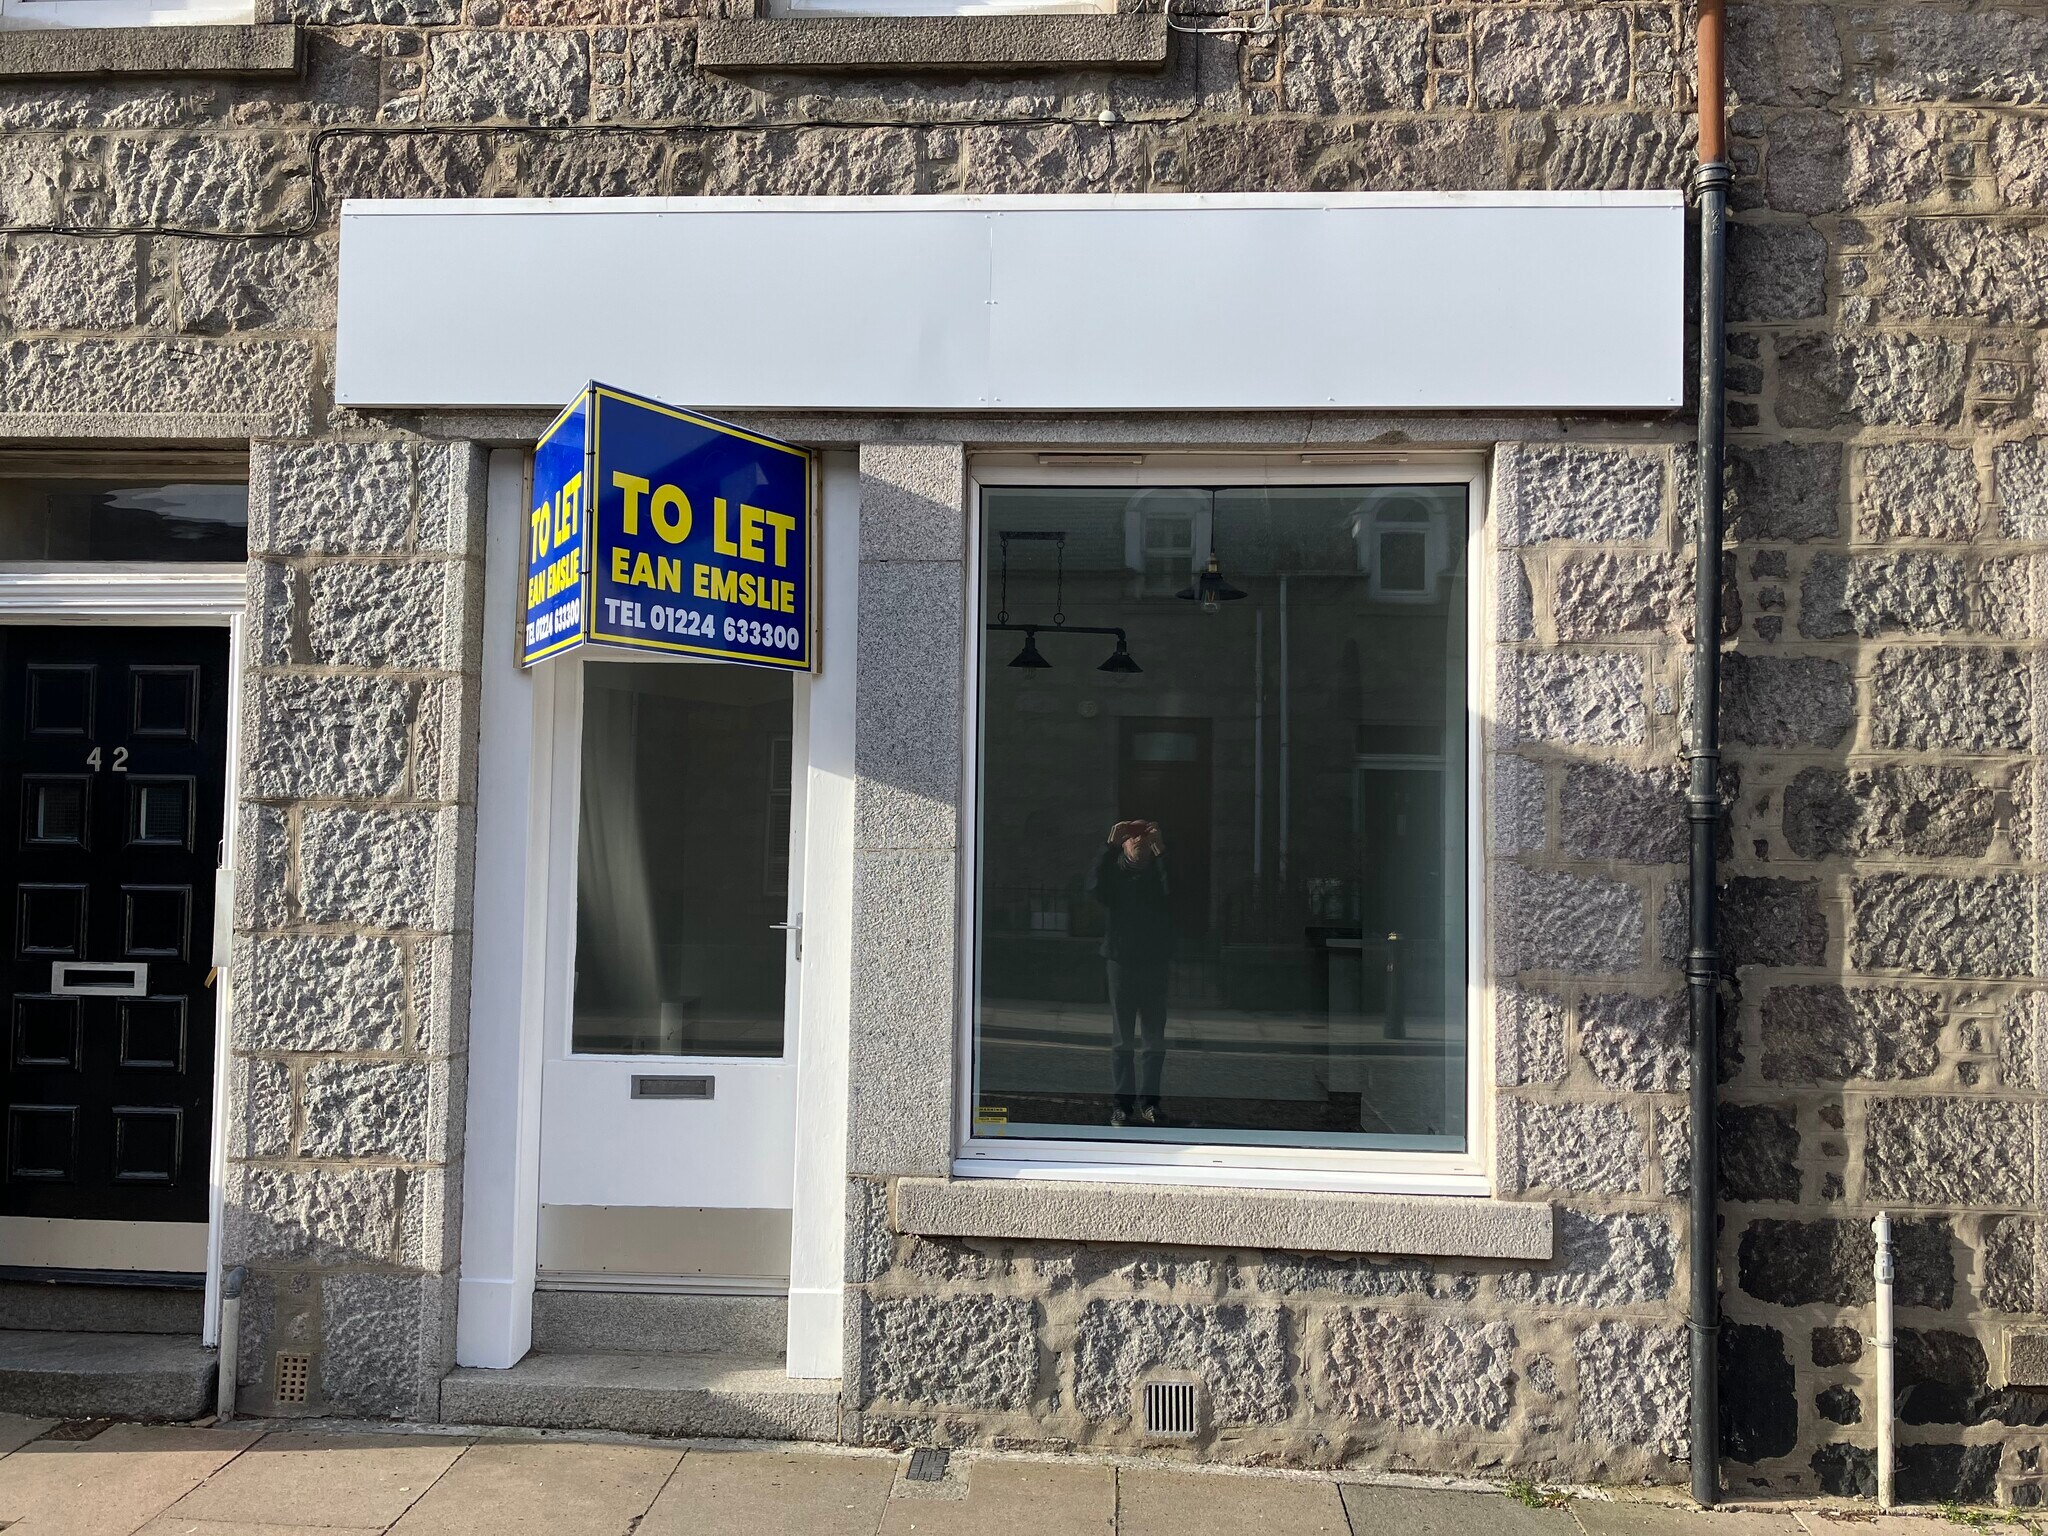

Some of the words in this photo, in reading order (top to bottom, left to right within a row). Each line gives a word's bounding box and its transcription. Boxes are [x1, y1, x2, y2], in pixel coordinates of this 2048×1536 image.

[531, 501, 550, 564] TO
[553, 471, 582, 549] LET
[612, 470, 692, 544] TO
[714, 496, 795, 567] LET
[528, 569, 546, 610] EAN
[547, 547, 580, 599] EMSLIE
[611, 546, 681, 593] EAN
[693, 563, 795, 613] EMSLIE
[526, 623, 535, 647] TEL
[536, 612, 553, 640] 01224
[554, 597, 580, 632] 633300
[604, 597, 646, 628] TEL
[650, 604, 715, 639] 01224
[723, 616, 799, 650] 633300
[86, 746, 129, 772] 42
